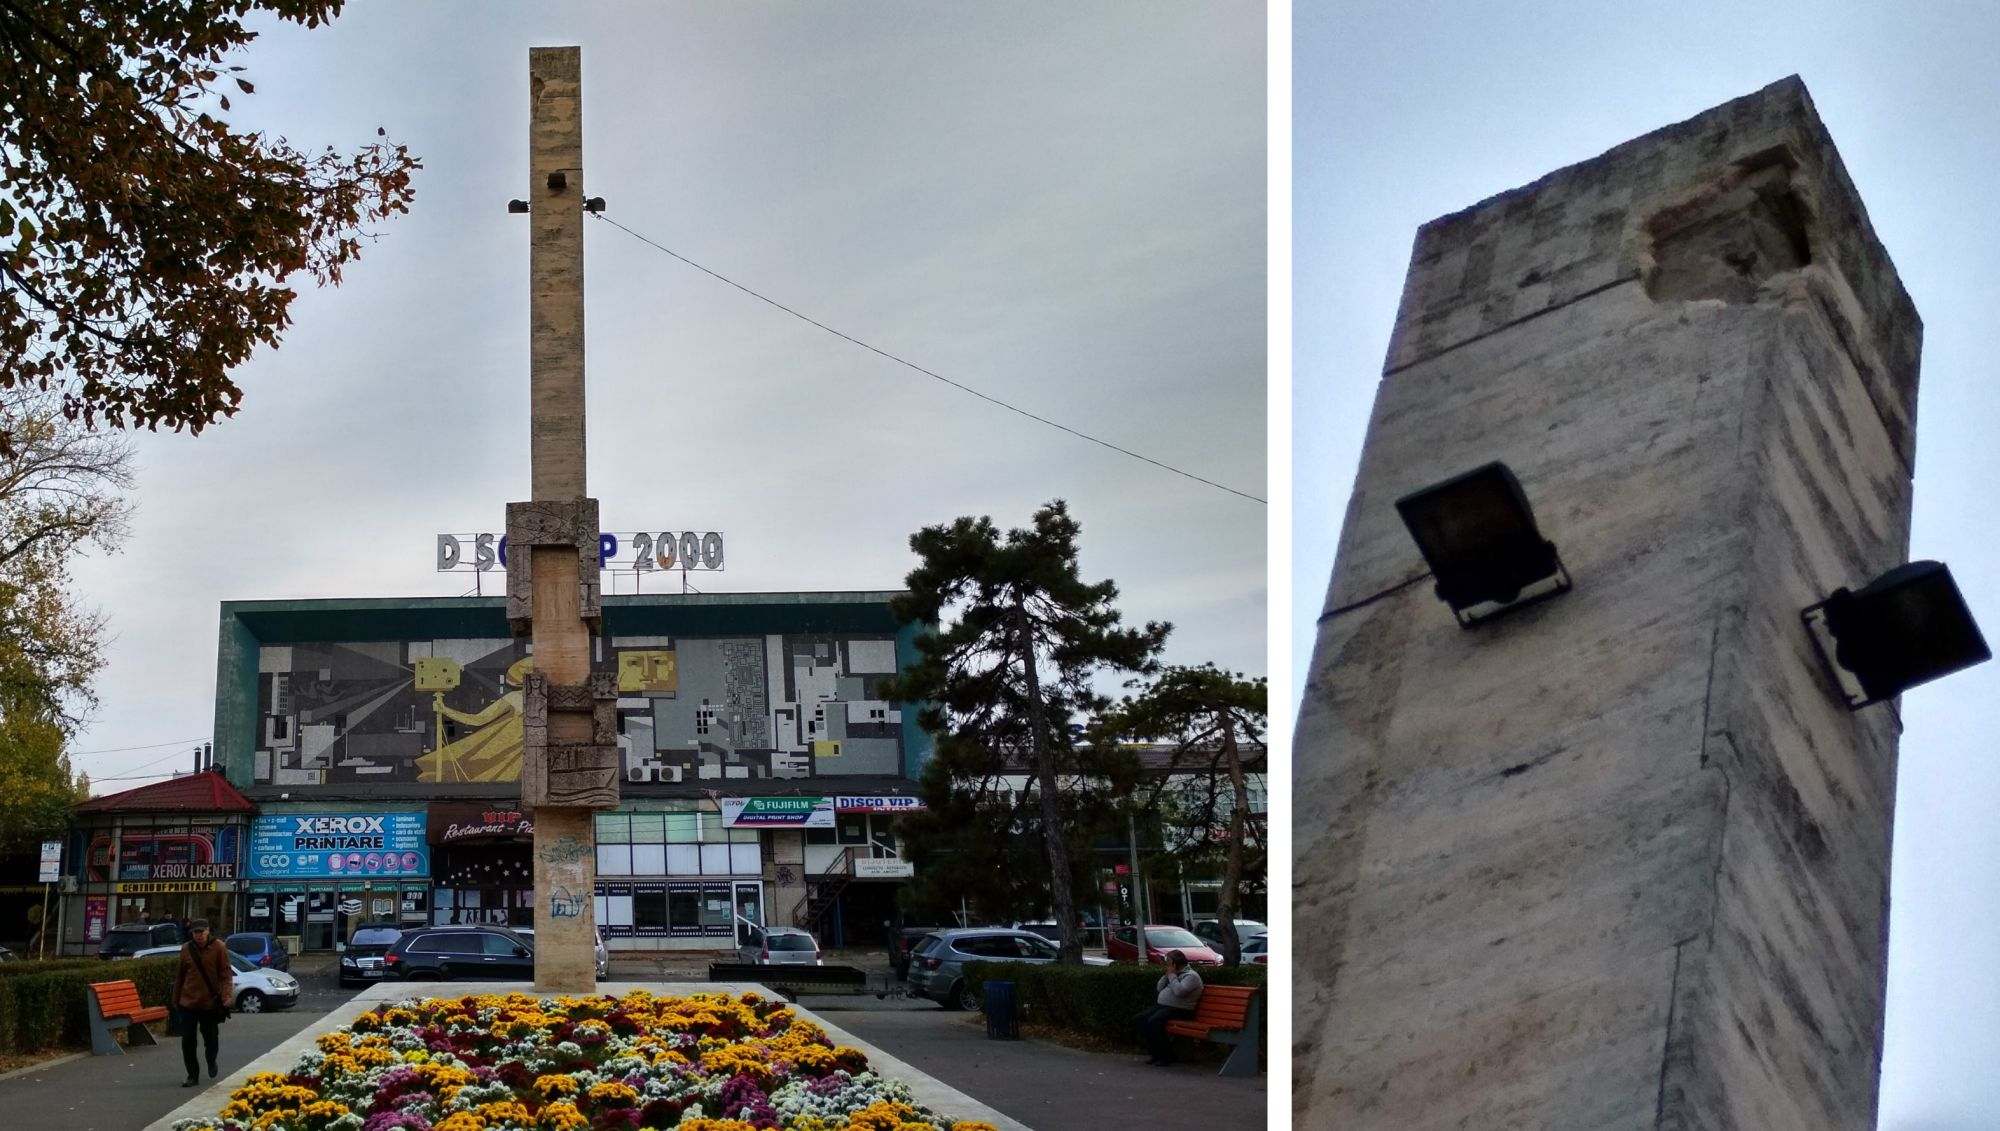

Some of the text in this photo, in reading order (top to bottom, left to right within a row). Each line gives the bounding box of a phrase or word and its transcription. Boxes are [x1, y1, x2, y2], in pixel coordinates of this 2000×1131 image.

[632, 531, 724, 571] 2000
[766, 800, 809, 810] FUJIFILM
[840, 797, 884, 809] DISCO
[887, 797, 914, 807] VIP
[295, 815, 385, 835] XEROX
[444, 822, 505, 841] Restaurant
[260, 854, 290, 868] ECO
[152, 863, 187, 879] XEROX
[190, 863, 233, 879] LICENTE
[168, 882, 213, 892] PRINTARE
